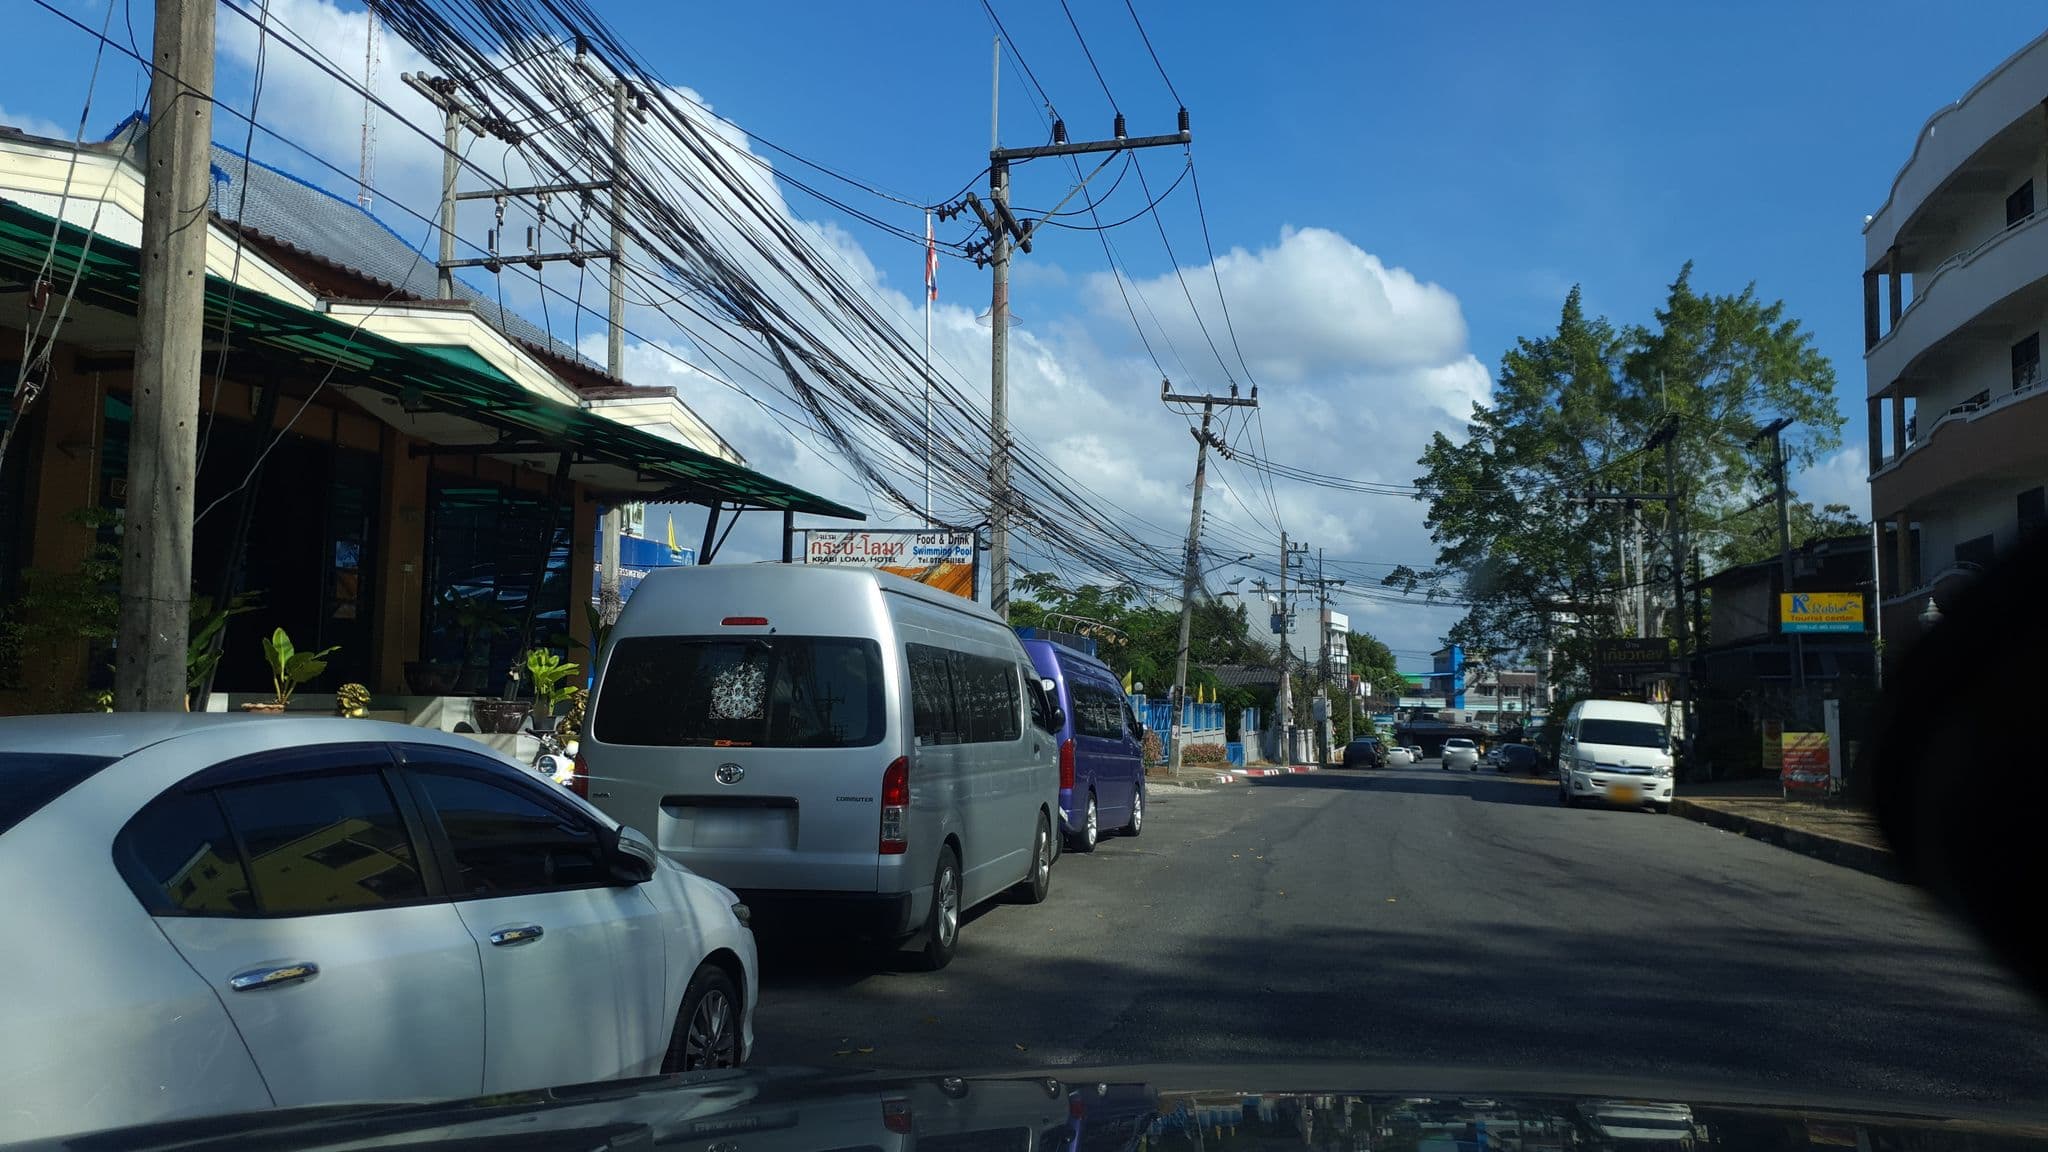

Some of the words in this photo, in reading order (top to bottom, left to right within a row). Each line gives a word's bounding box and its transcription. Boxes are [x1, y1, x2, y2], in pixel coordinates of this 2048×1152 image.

[916, 534, 936, 544] Food
[939, 534, 945, 544] &
[948, 534, 969, 545] Drink
[913, 546, 952, 557] Swimming
[955, 546, 972, 556] Pool
